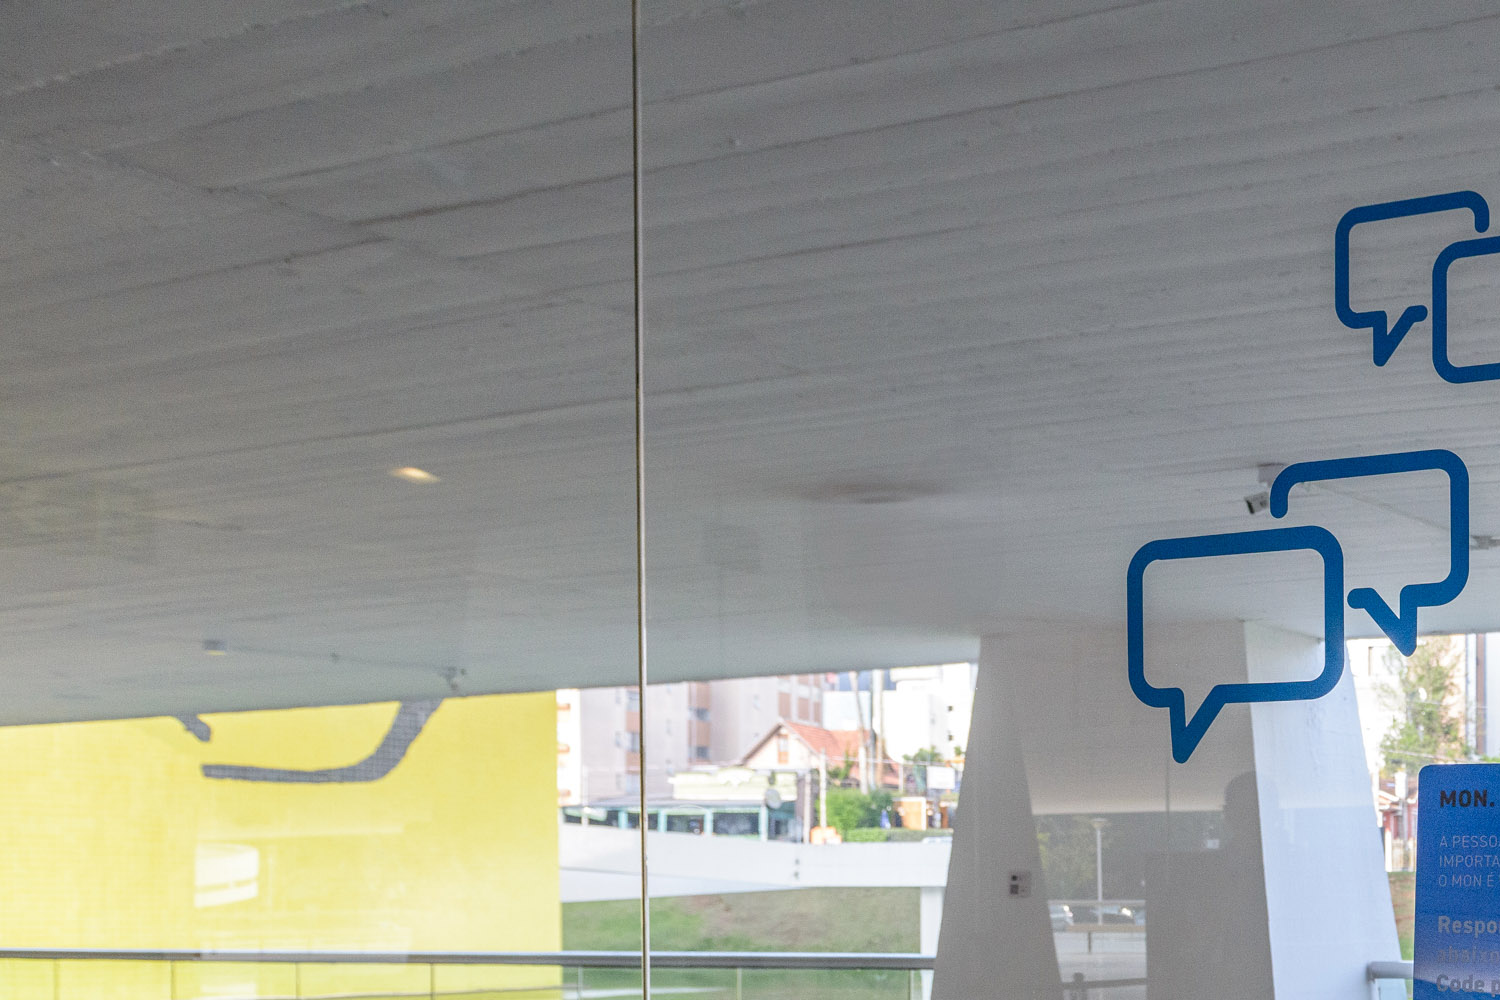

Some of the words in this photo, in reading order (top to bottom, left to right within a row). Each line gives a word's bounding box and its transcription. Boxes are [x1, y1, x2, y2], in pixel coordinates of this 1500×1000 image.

[1440, 789, 1495, 808] MON.
[1440, 836, 1448, 847] A
[1439, 875, 1447, 887] O
[1452, 875, 1482, 887] MON
[1487, 871, 1495, 887] É
[1437, 974, 1484, 993] Code
